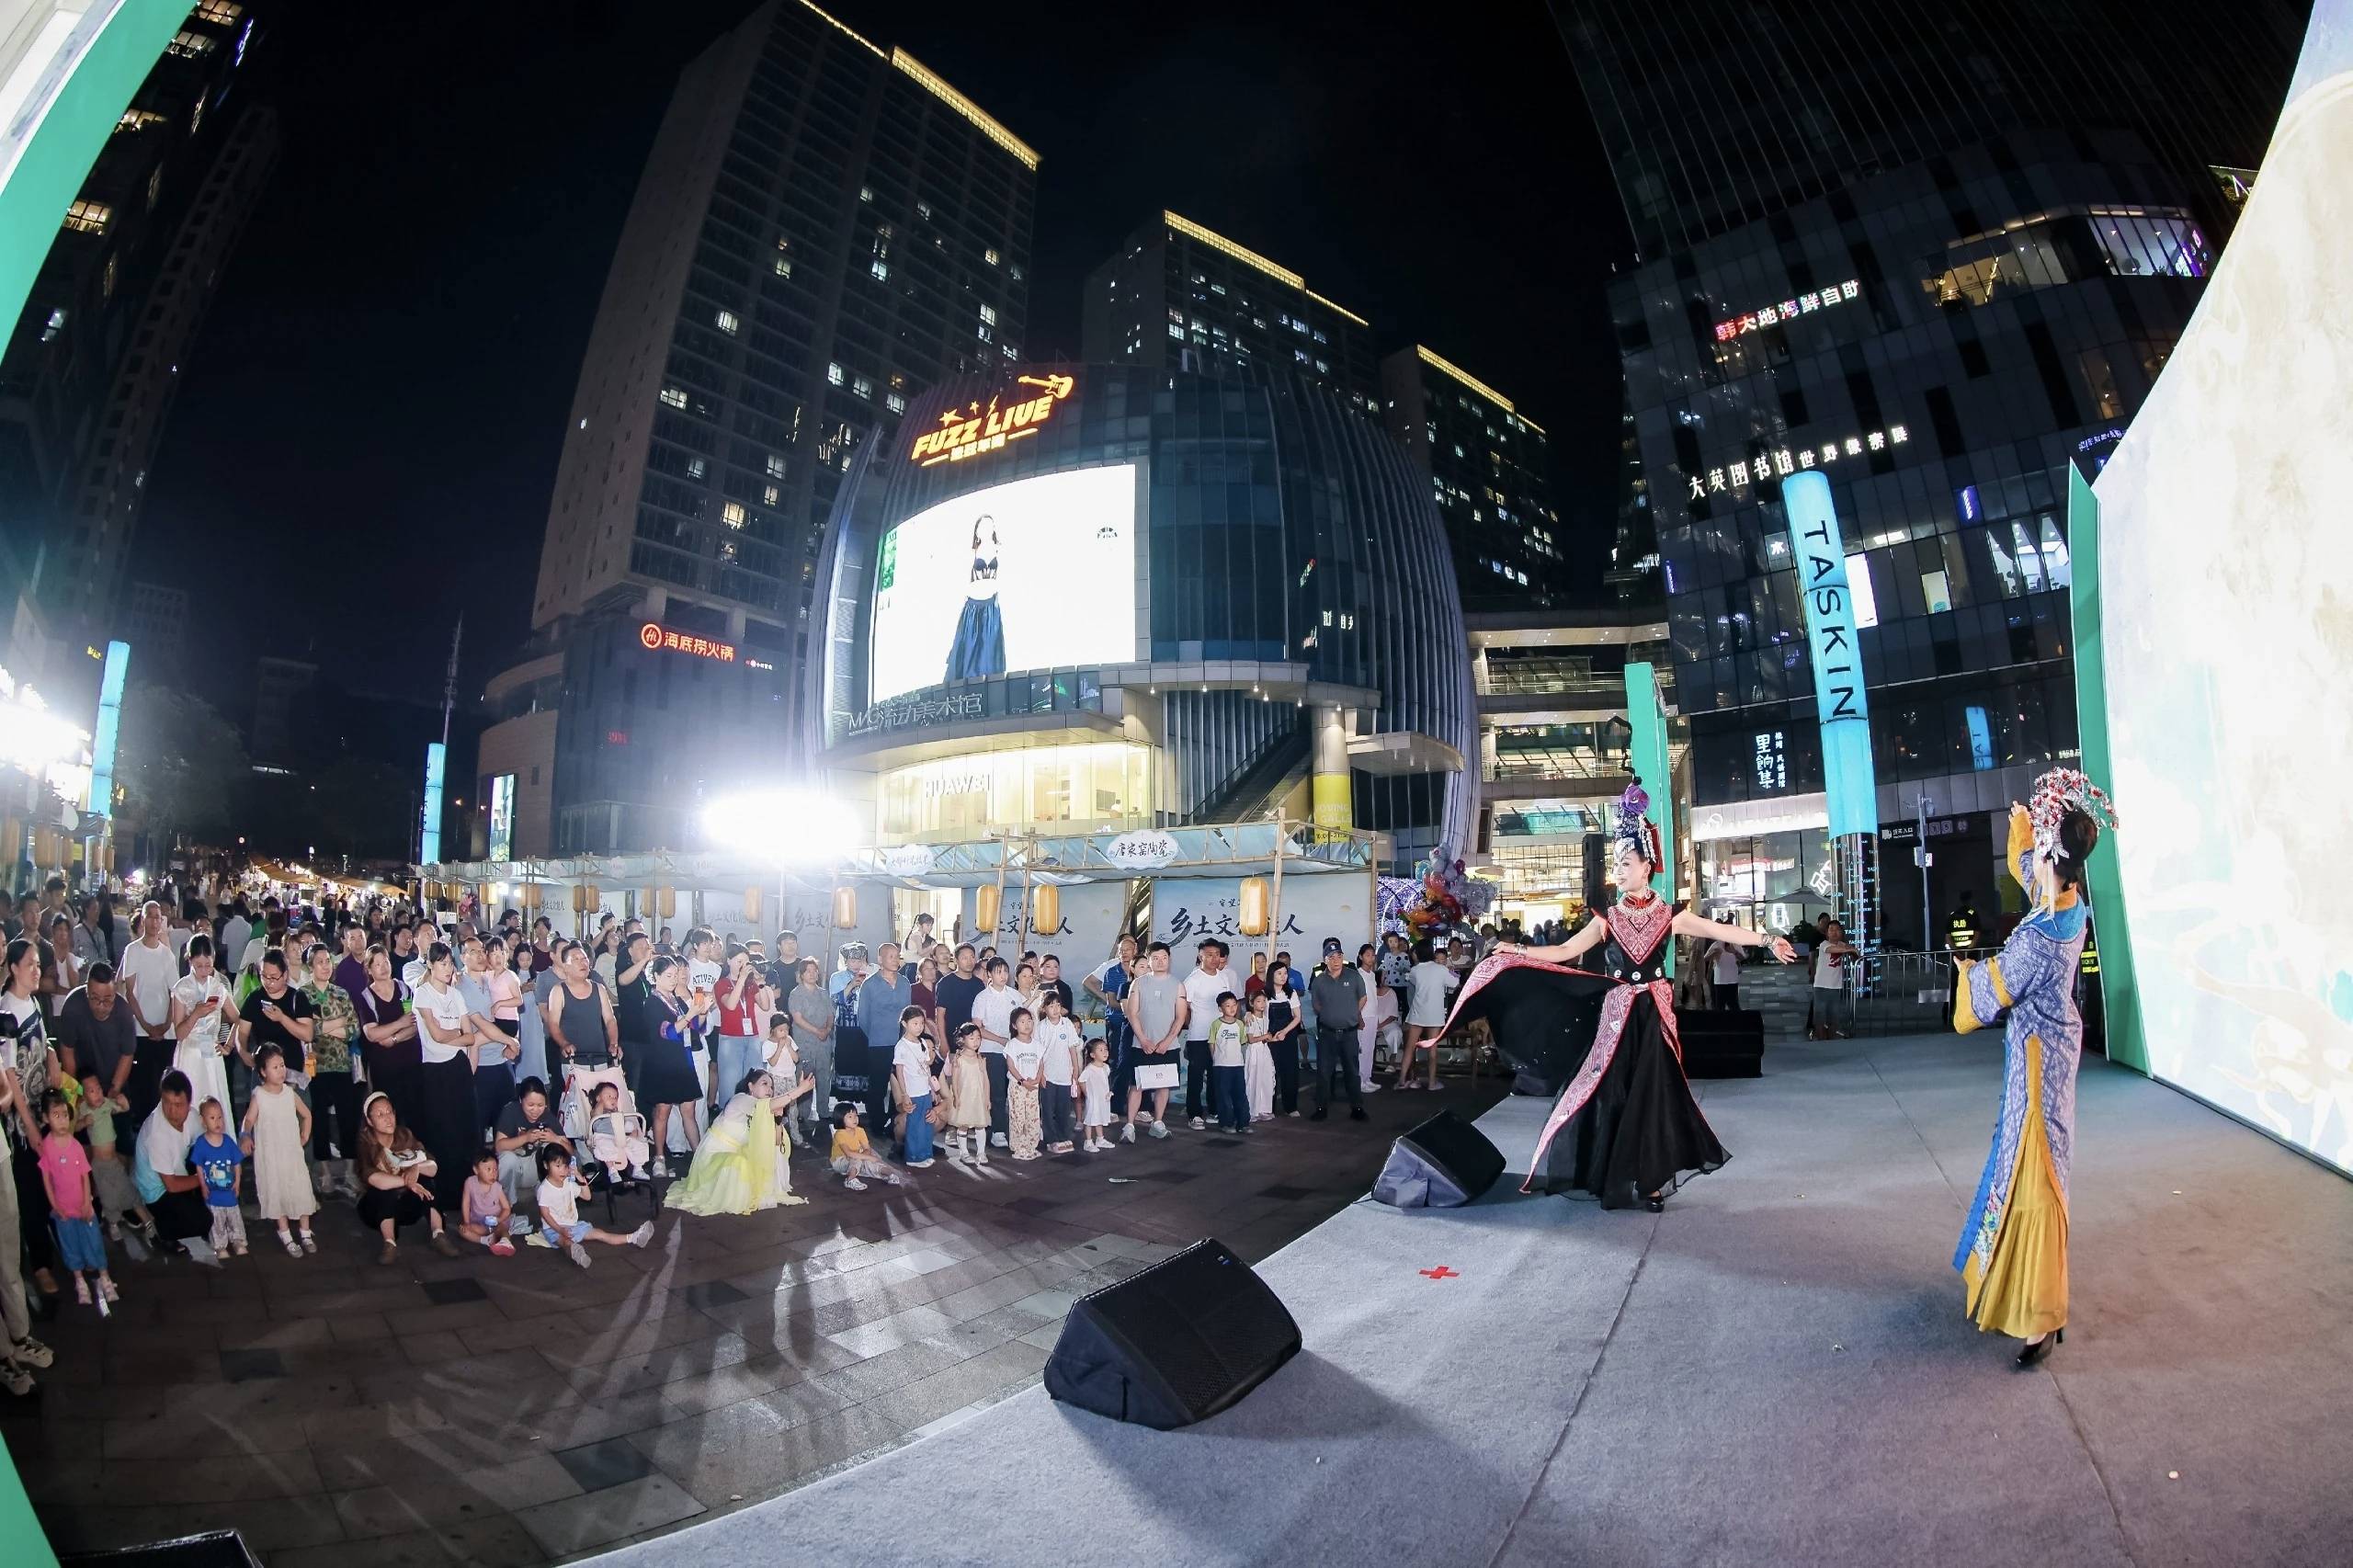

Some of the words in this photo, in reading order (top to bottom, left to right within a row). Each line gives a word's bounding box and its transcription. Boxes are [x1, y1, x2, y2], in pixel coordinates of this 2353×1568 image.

[1715, 279, 1859, 341] 韩大地海鲜自助
[911, 417, 982, 460] FUZZ
[985, 394, 1054, 437] LIVE
[664, 631, 733, 662] 海底捞火锅
[1804, 519, 1857, 717] TASKIN
[1169, 907, 1304, 947] 乡土文人
